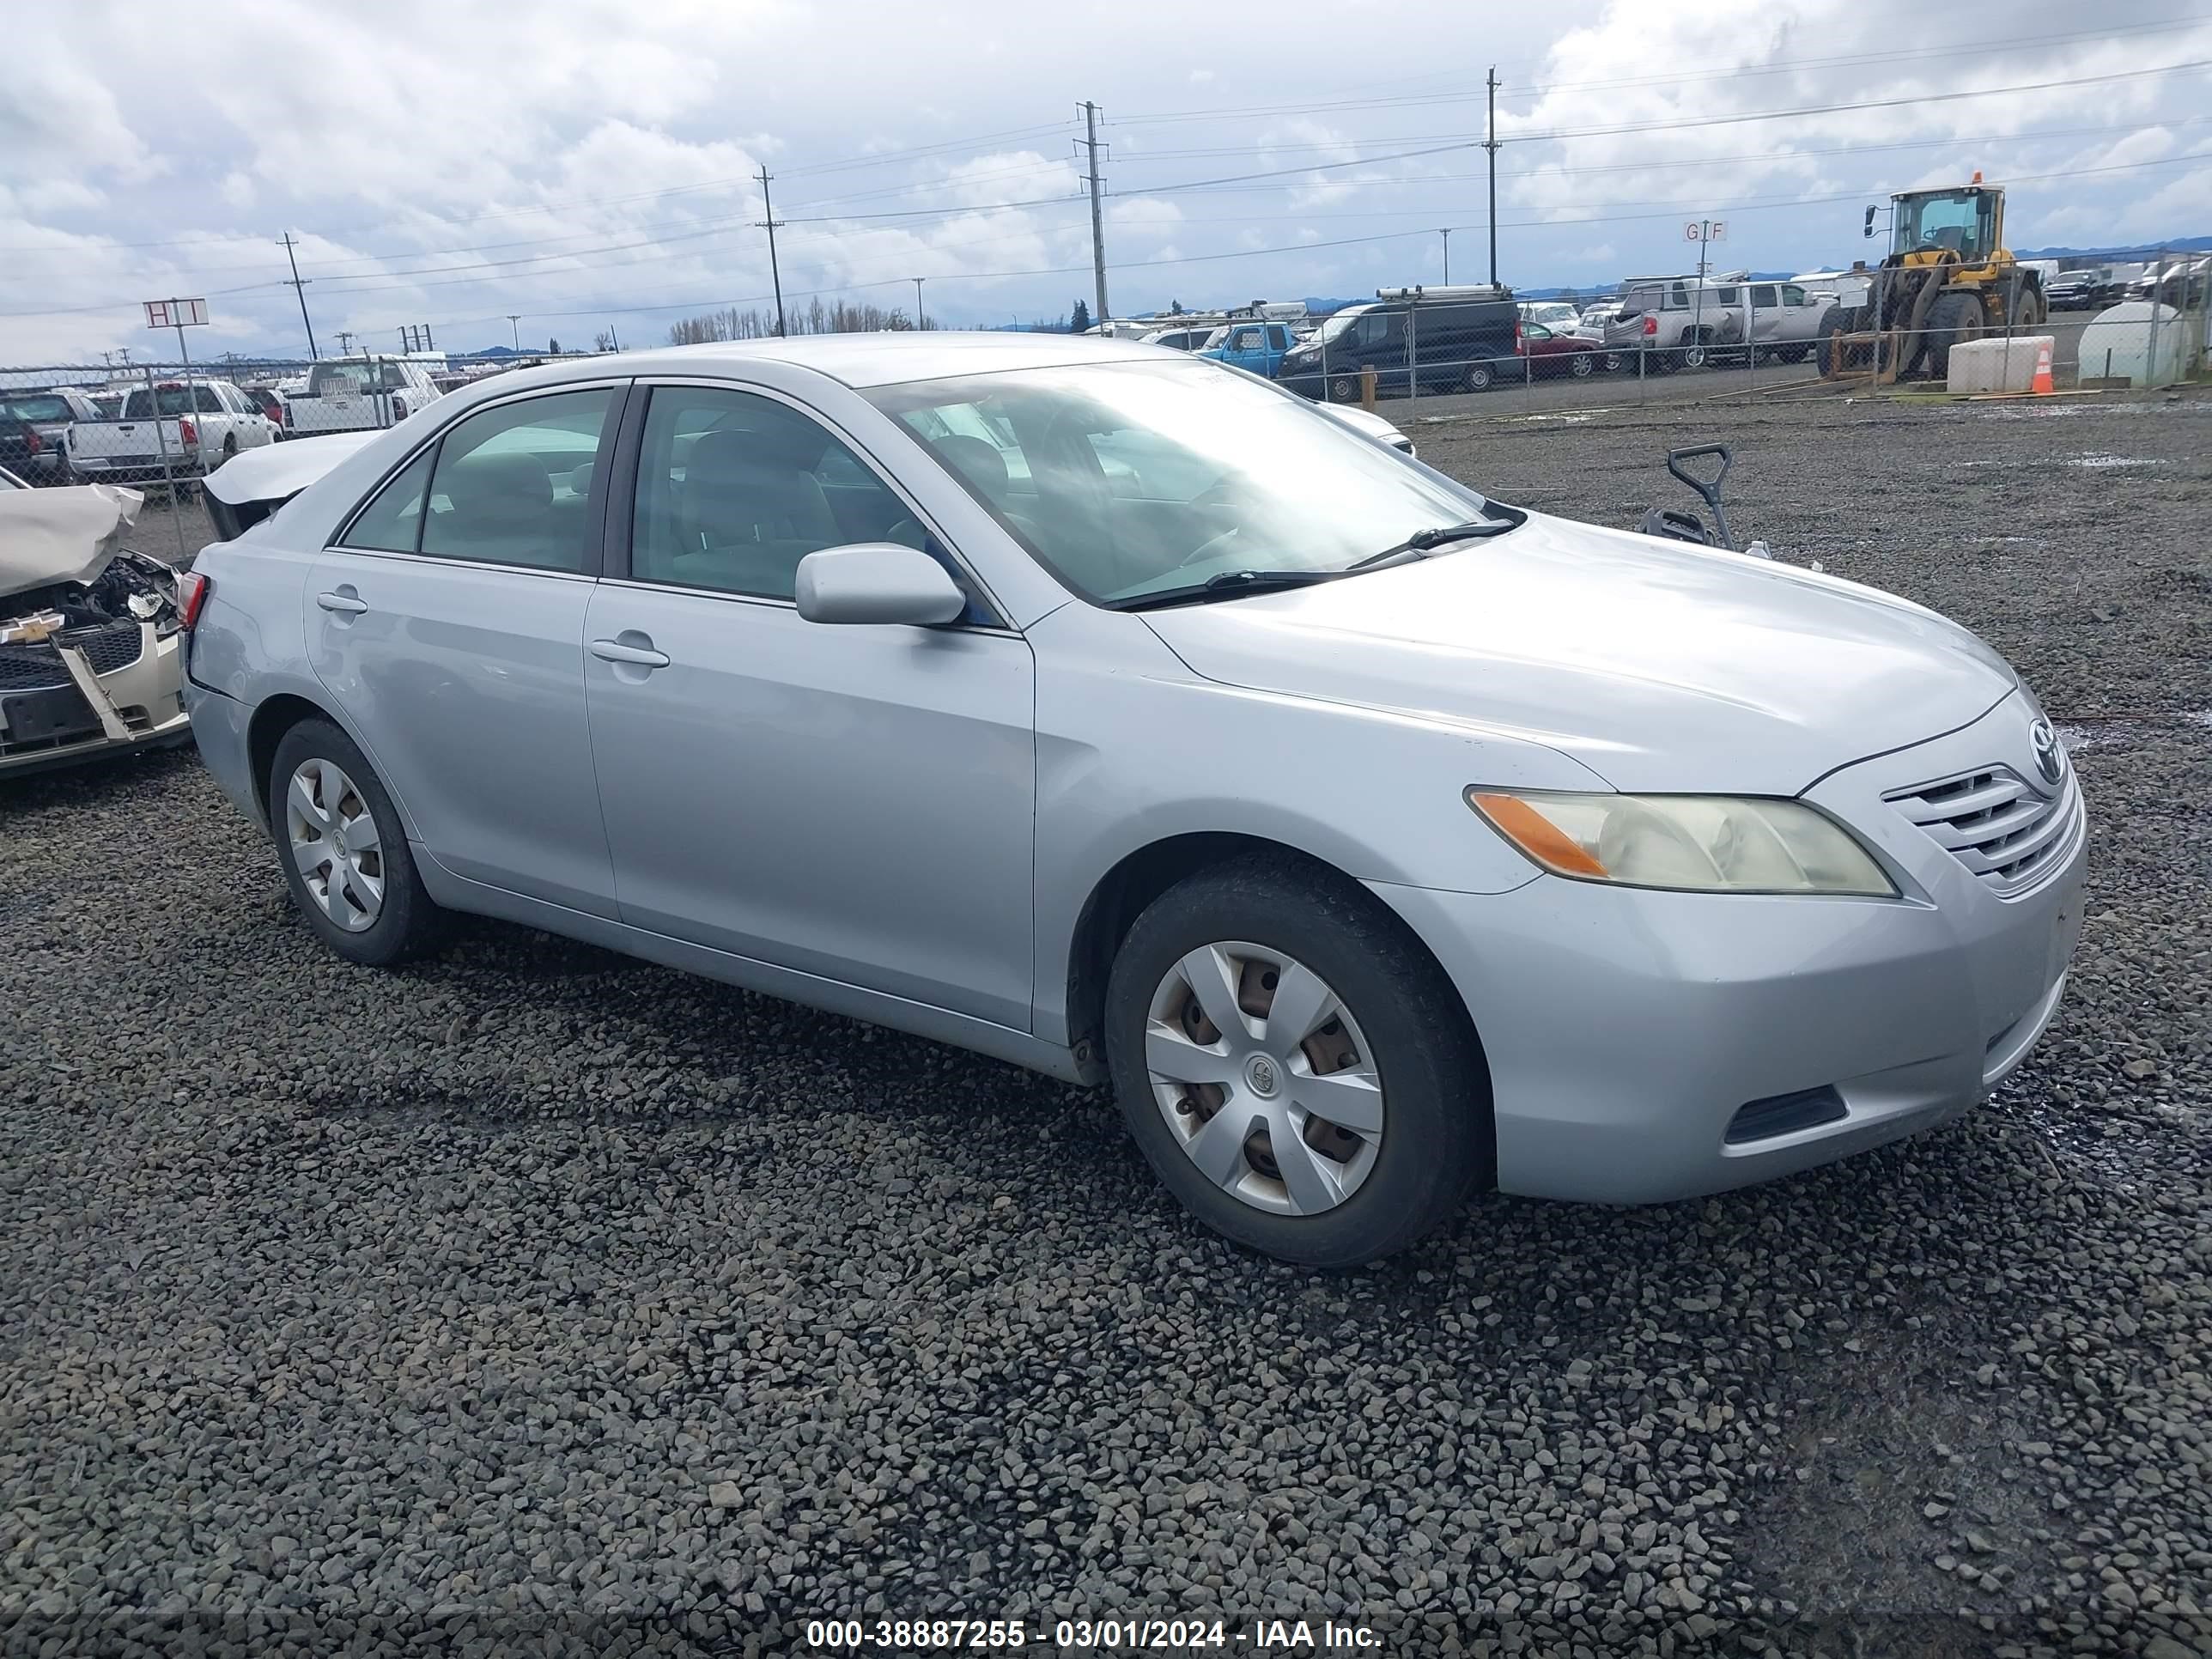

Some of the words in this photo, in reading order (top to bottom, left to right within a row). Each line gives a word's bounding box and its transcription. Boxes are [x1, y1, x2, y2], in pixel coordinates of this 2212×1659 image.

[1686, 223, 1698, 240] G
[1712, 222, 1723, 240] F
[148, 302, 169, 325] H
[320, 378, 359, 391] NATIONAL
